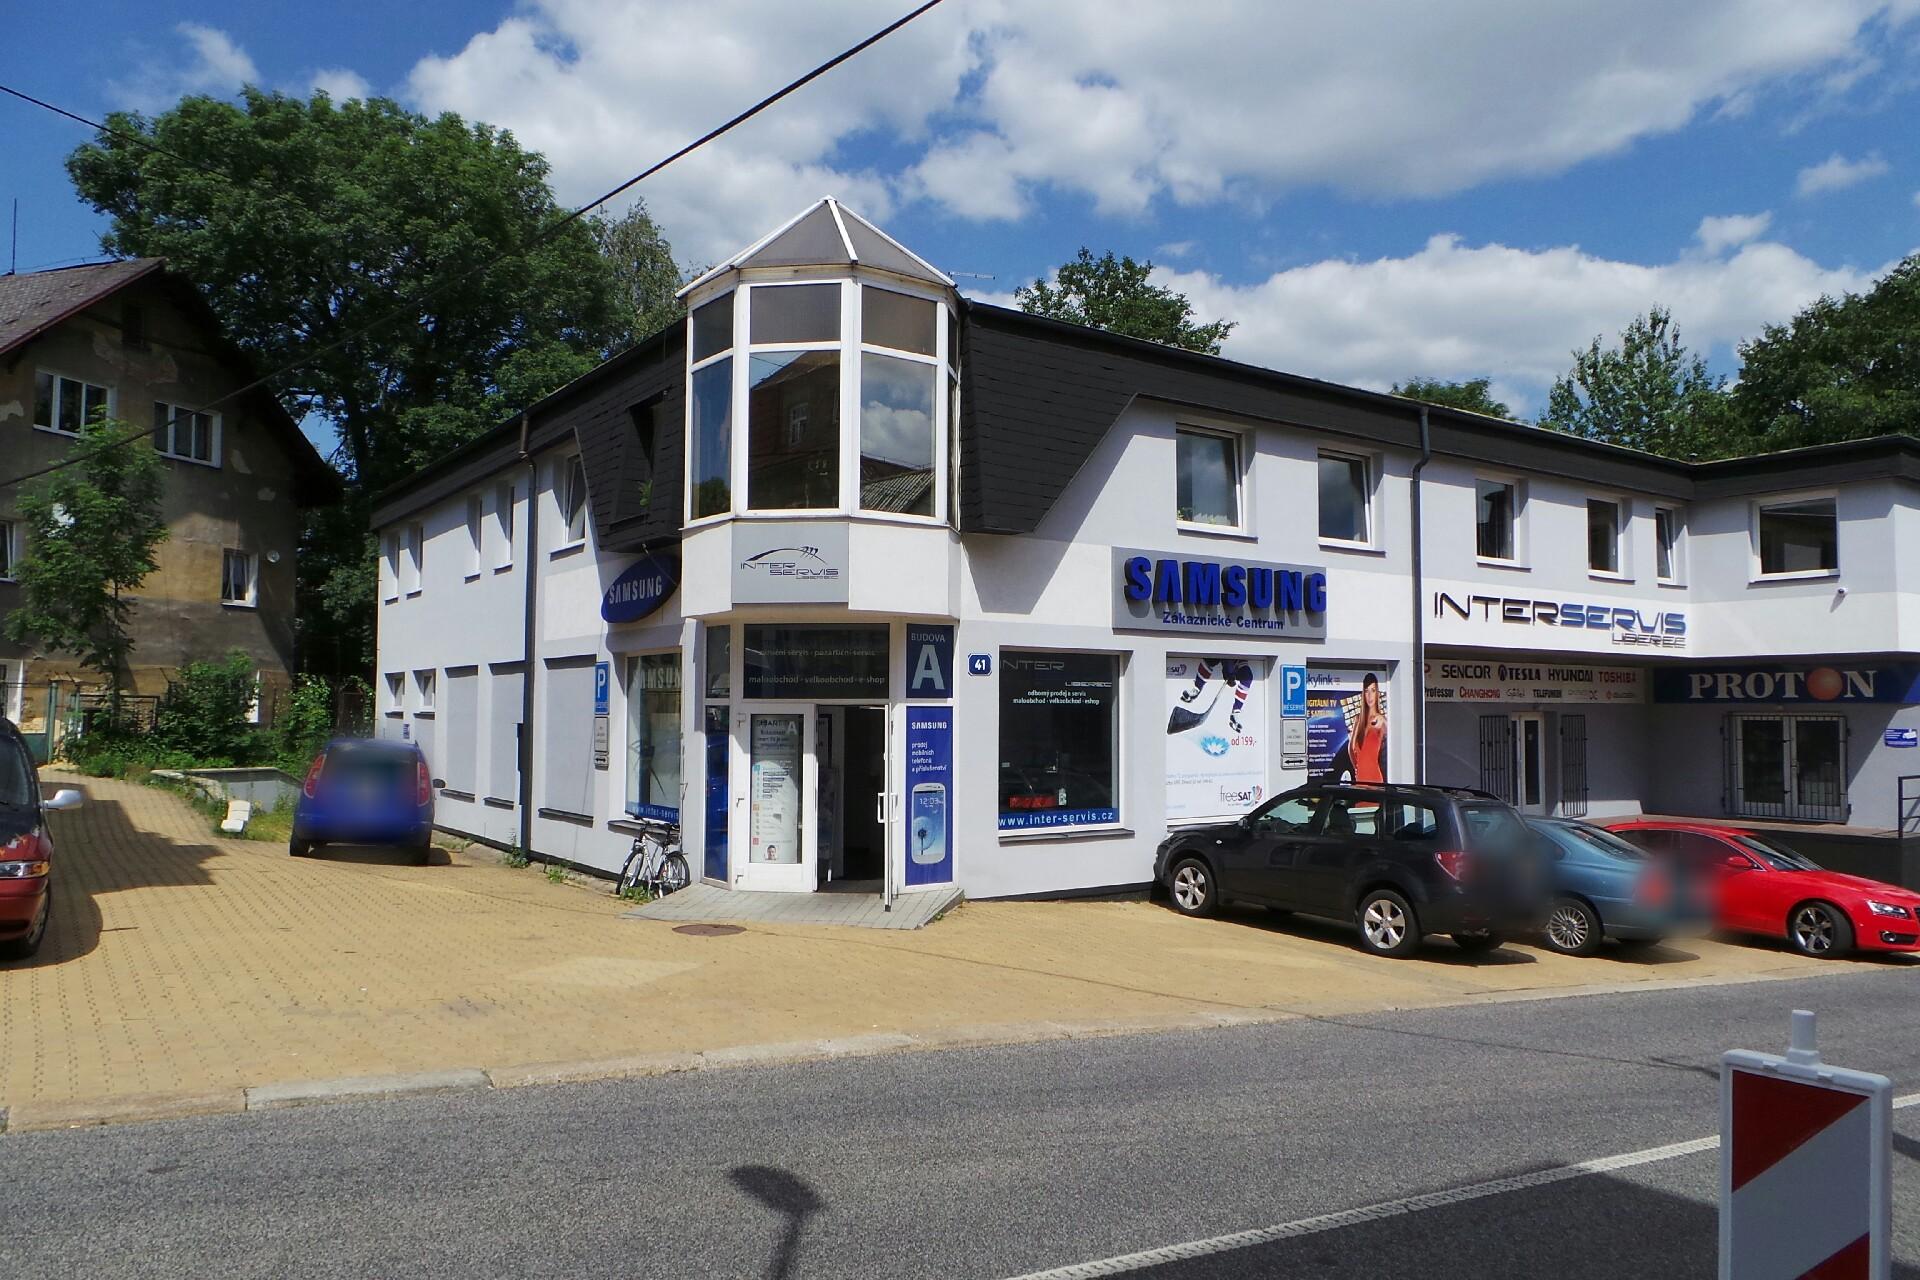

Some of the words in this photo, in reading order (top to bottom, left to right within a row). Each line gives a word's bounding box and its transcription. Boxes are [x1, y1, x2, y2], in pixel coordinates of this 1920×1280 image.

[740, 562, 795, 570] INTER
[769, 568, 839, 576] SERVIS
[608, 575, 663, 605] SAMSUNG
[1124, 556, 1327, 613] SAMSUNG
[1162, 611, 1232, 627] Zákaznické
[1236, 615, 1285, 630] Centrum
[911, 632, 946, 642] BUDOVA
[911, 644, 946, 690] A
[974, 659, 987, 671] 41
[1000, 660, 1065, 671] INTER
[1441, 664, 1491, 679] SENCOR
[1508, 667, 1541, 681] TESLA
[1548, 668, 1593, 682] HYUNDAI
[597, 668, 606, 698] P
[1286, 671, 1301, 701] P
[911, 721, 948, 730] SAMSUNG
[911, 741, 928, 750] prodej
[1231, 736, 1240, 746] od
[1220, 785, 1252, 802] freeSAT
[999, 810, 1113, 827] www.inter-servis.cz
